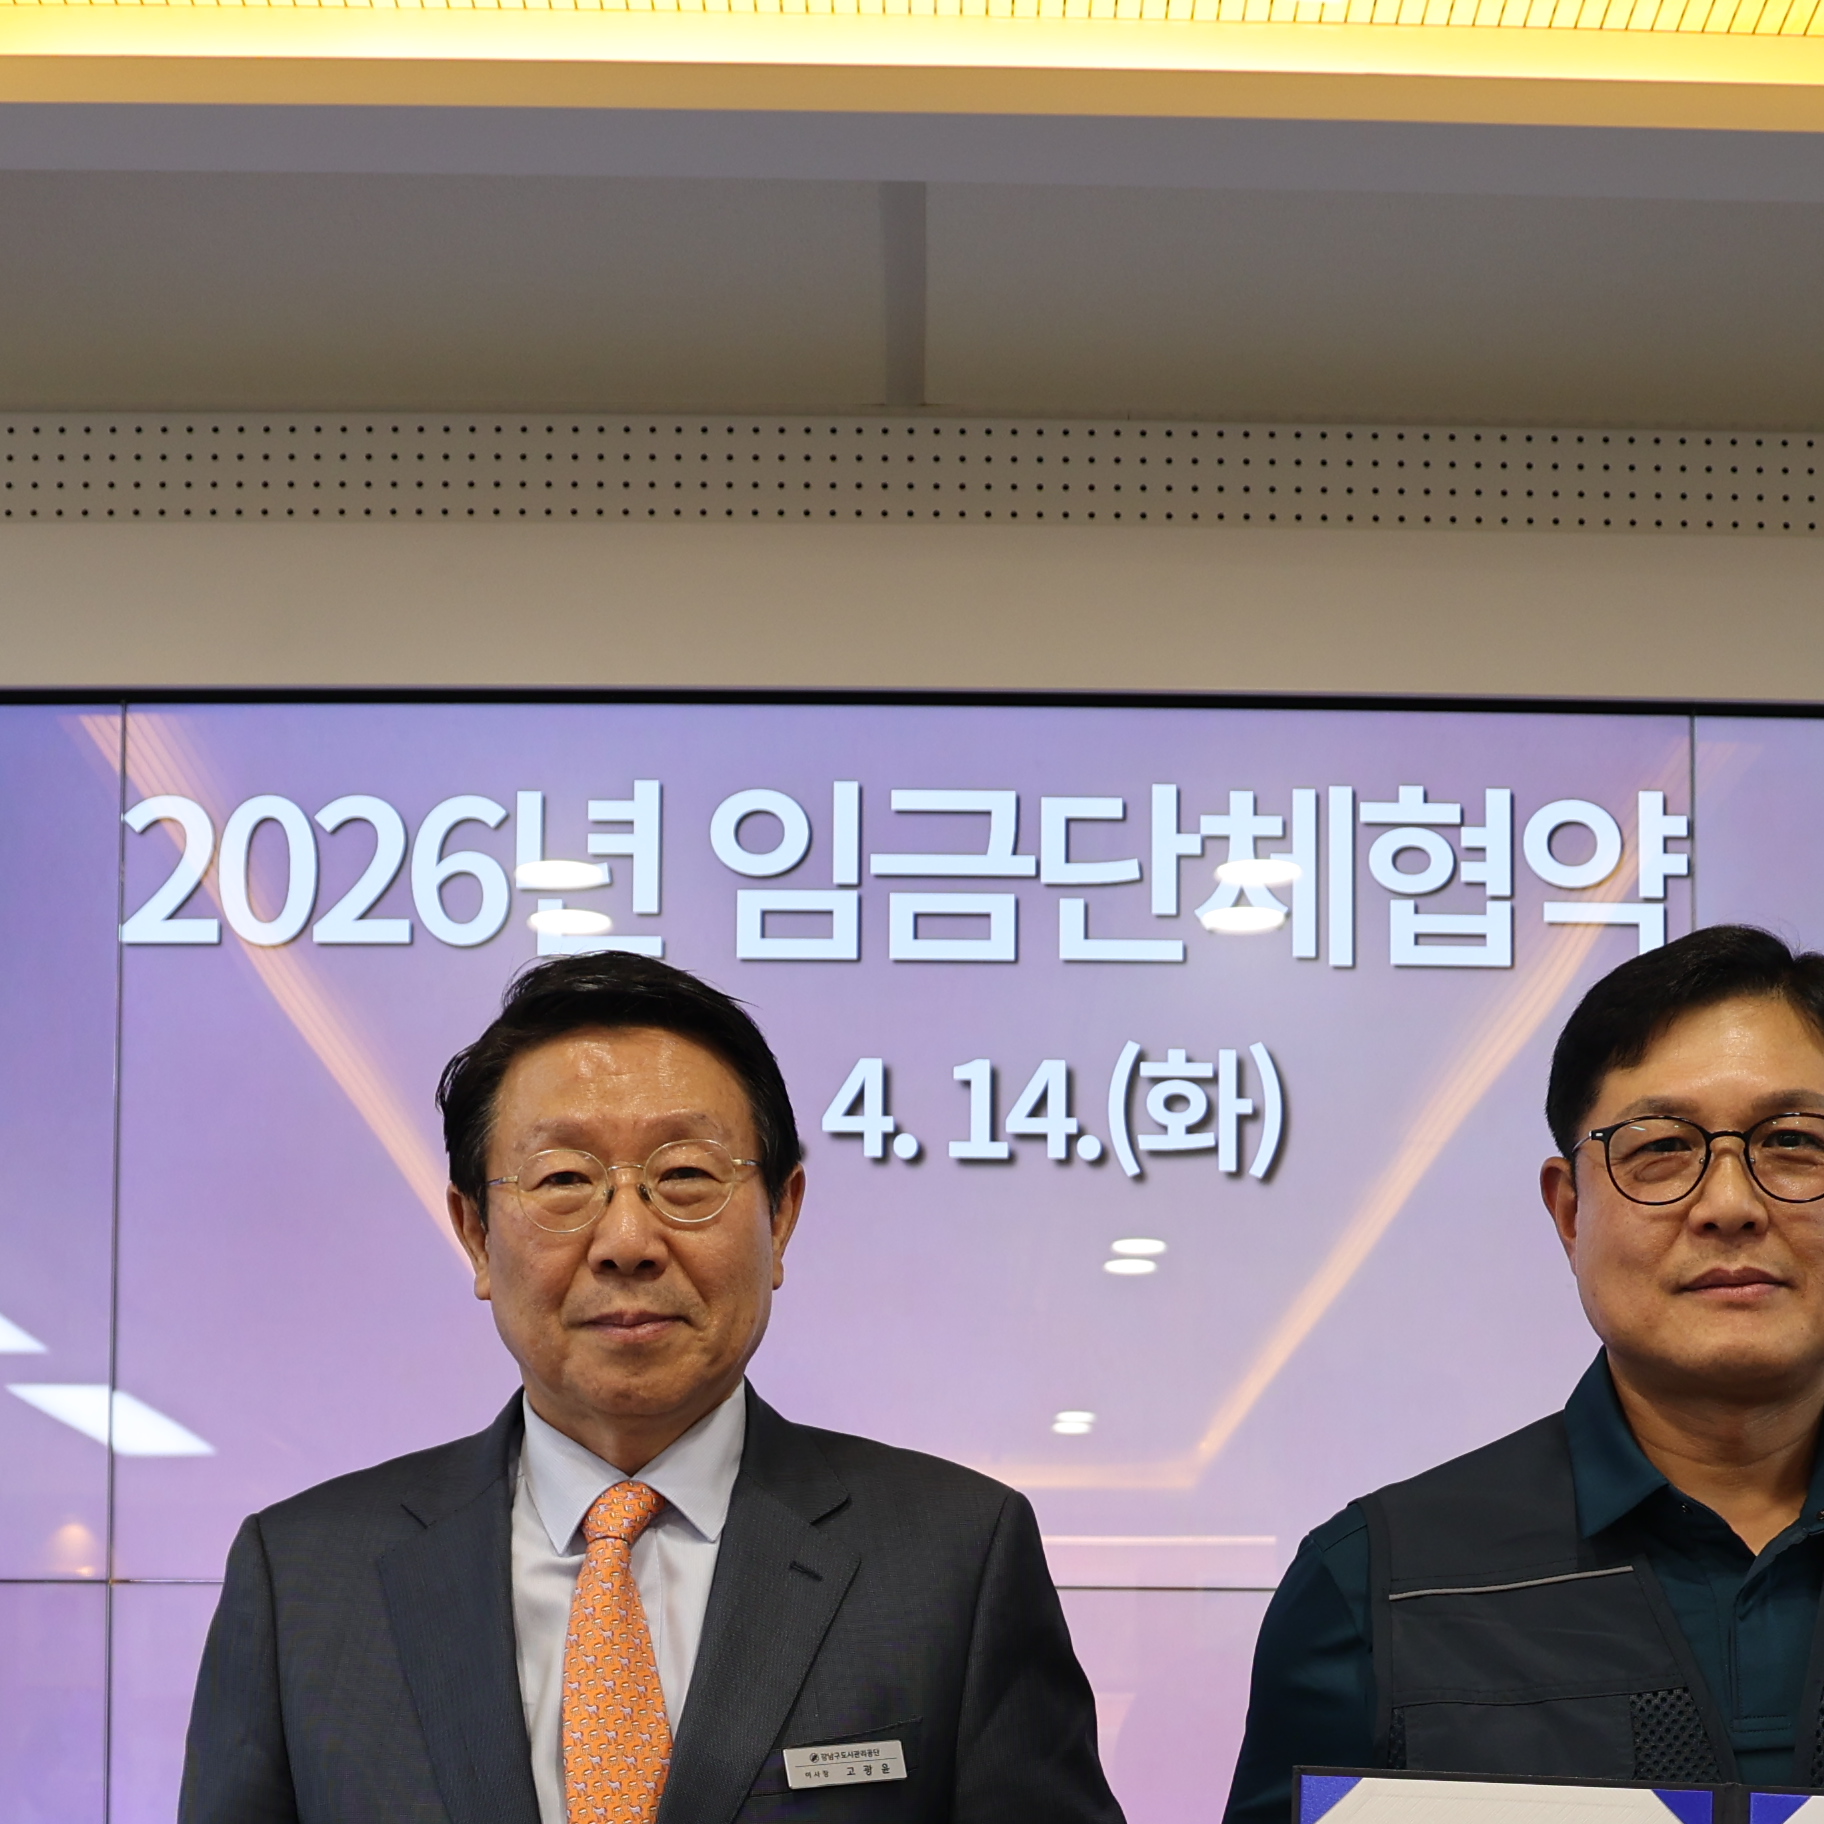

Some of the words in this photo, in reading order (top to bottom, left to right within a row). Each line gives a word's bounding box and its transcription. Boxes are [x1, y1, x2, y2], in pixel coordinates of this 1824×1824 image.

[119, 779, 664, 958] 2026년
[710, 780, 1689, 967] 임금단체협약
[822, 1057, 919, 1160] 4.
[948, 1040, 1283, 1179] 14.(화)
